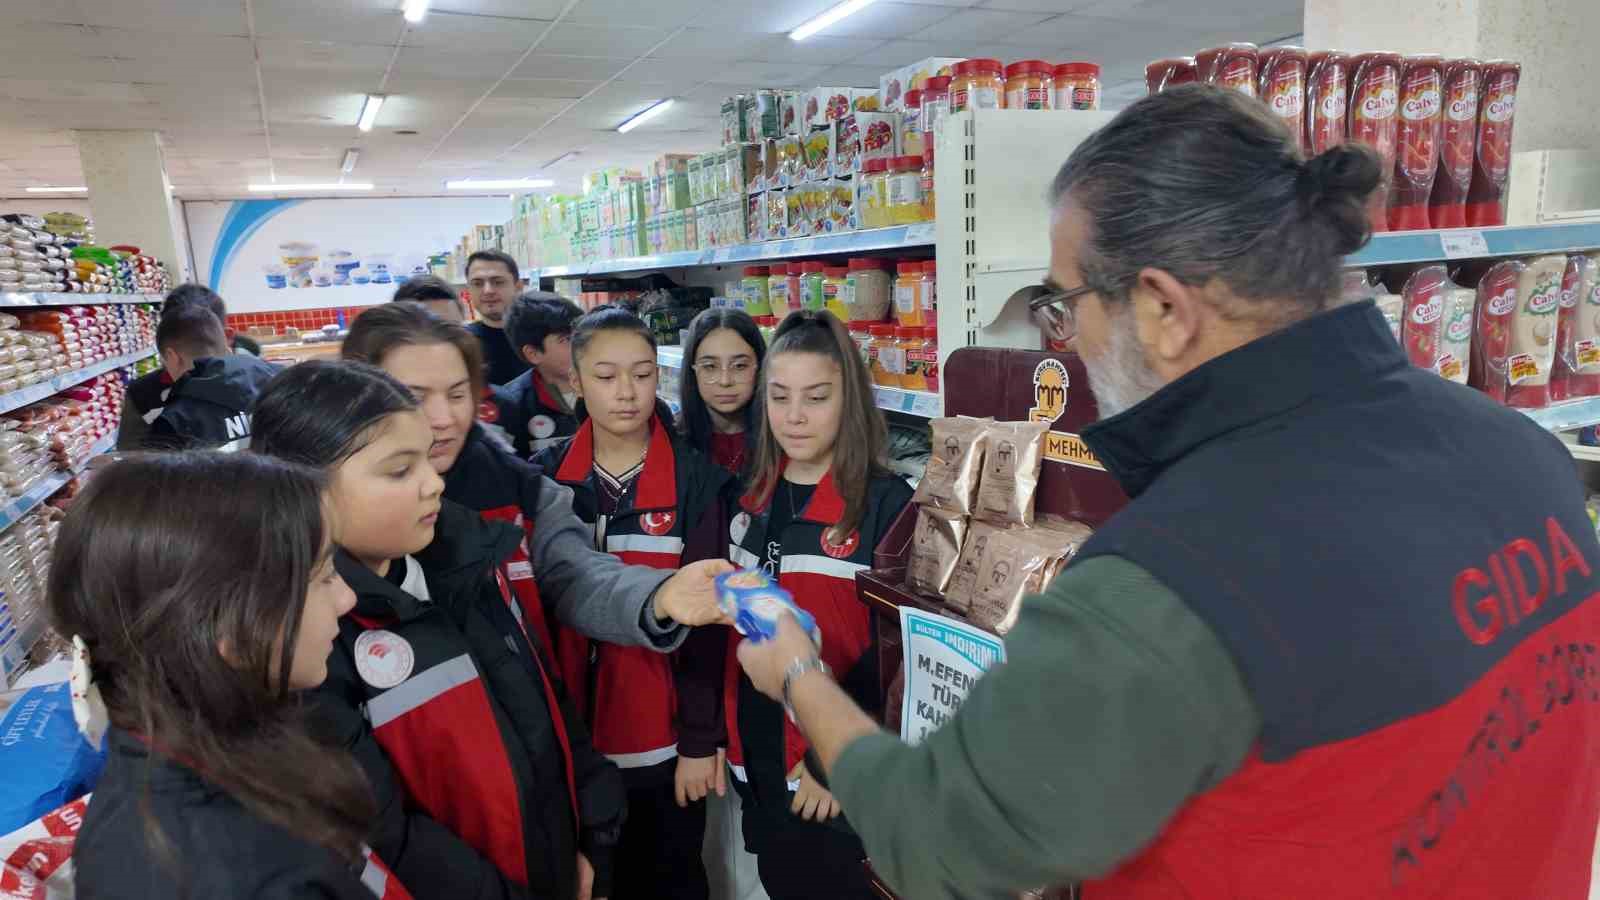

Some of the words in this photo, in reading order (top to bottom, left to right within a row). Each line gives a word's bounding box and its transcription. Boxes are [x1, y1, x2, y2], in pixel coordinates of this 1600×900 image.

[224, 411, 253, 439] Nİ
[1048, 437, 1098, 462] MEHM
[1450, 516, 1591, 645] GIDA
[918, 653, 977, 691] M.EFEN
[931, 683, 961, 711] TÜR
